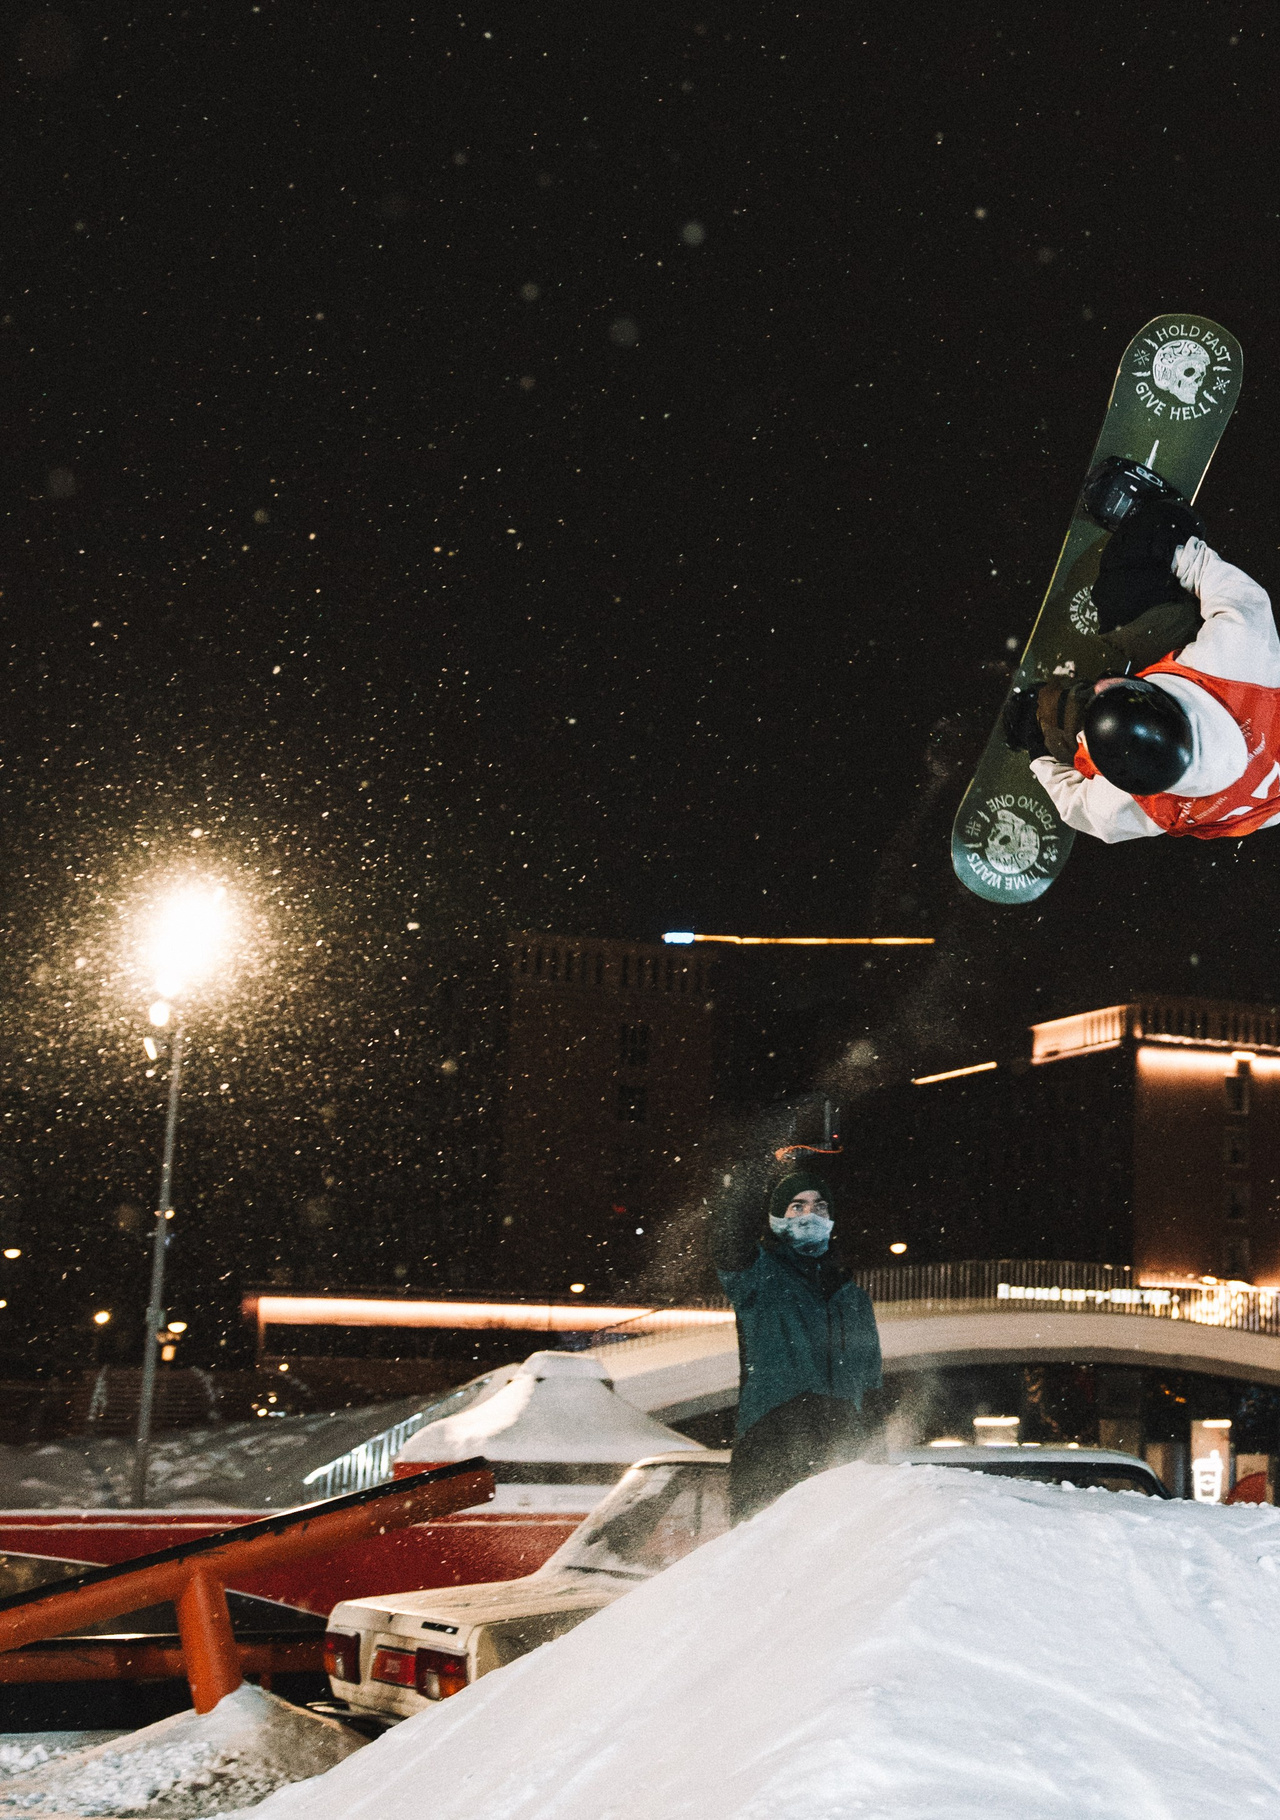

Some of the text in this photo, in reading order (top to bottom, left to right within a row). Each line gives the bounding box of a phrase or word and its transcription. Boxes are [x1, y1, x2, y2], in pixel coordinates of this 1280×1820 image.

[1156, 324, 1201, 342] HOLD
[1201, 331, 1231, 362] FAST
[1135, 381, 1211, 421] GIVE HELL
[1069, 585, 1094, 636] PARKITE
[986, 794, 1057, 831] FOR NO ONE
[966, 852, 1041, 891] TIME WAITS
